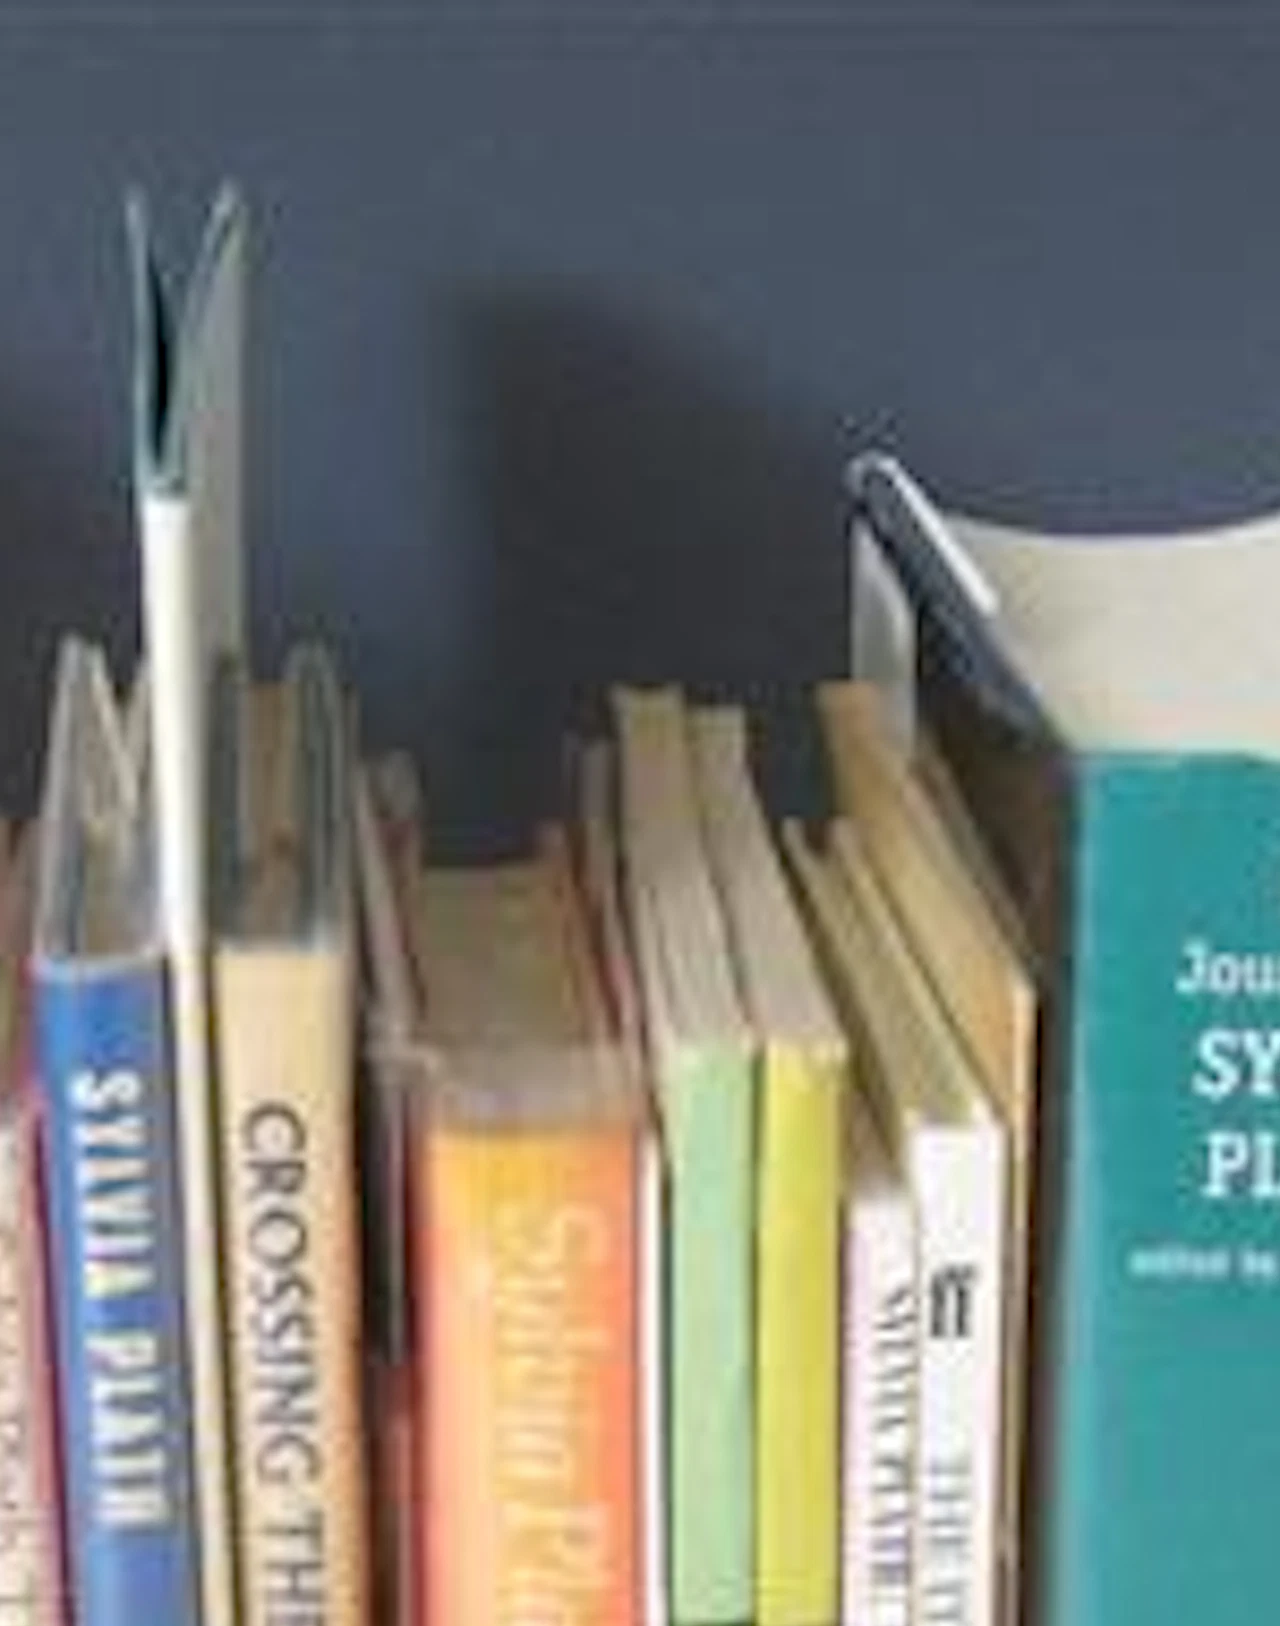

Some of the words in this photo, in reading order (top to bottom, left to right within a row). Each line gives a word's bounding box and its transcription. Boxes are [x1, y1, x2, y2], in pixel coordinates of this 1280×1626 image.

[70, 1066, 170, 1300] SYLVIA
[240, 1098, 325, 1488] CROSSING
[88, 1330, 178, 1530] PLATH
[923, 1455, 974, 1555] THE
